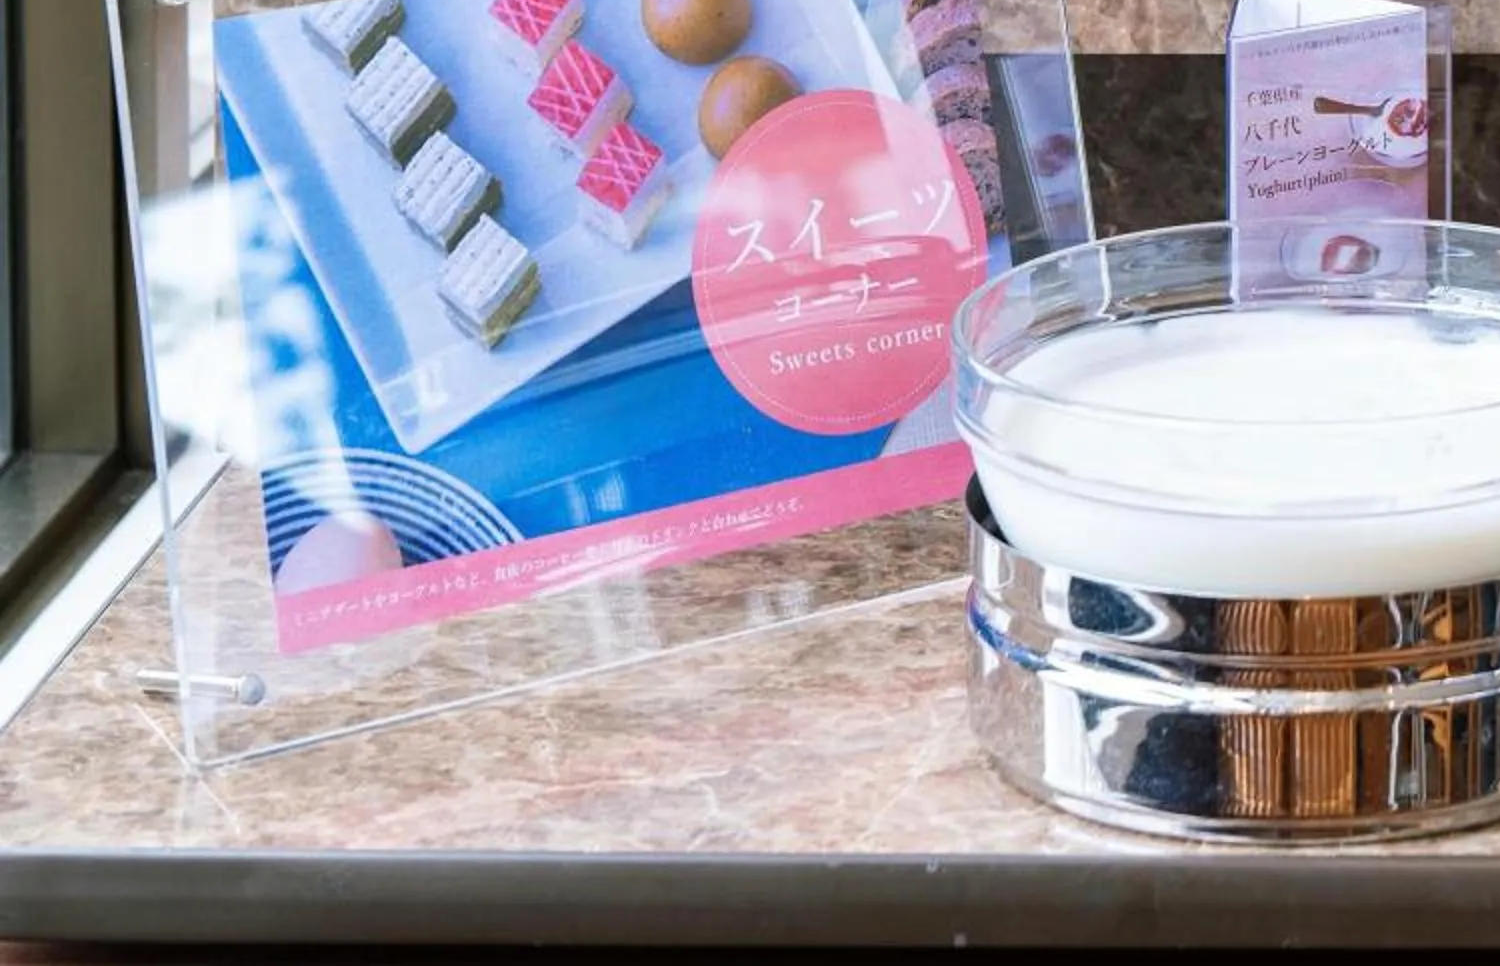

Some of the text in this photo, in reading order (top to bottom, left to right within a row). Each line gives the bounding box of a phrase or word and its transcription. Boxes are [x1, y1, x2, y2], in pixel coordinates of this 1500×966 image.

[725, 179, 956, 274] スイーツ
[774, 272, 919, 322] コーナー
[769, 321, 946, 376] Sweets corner
